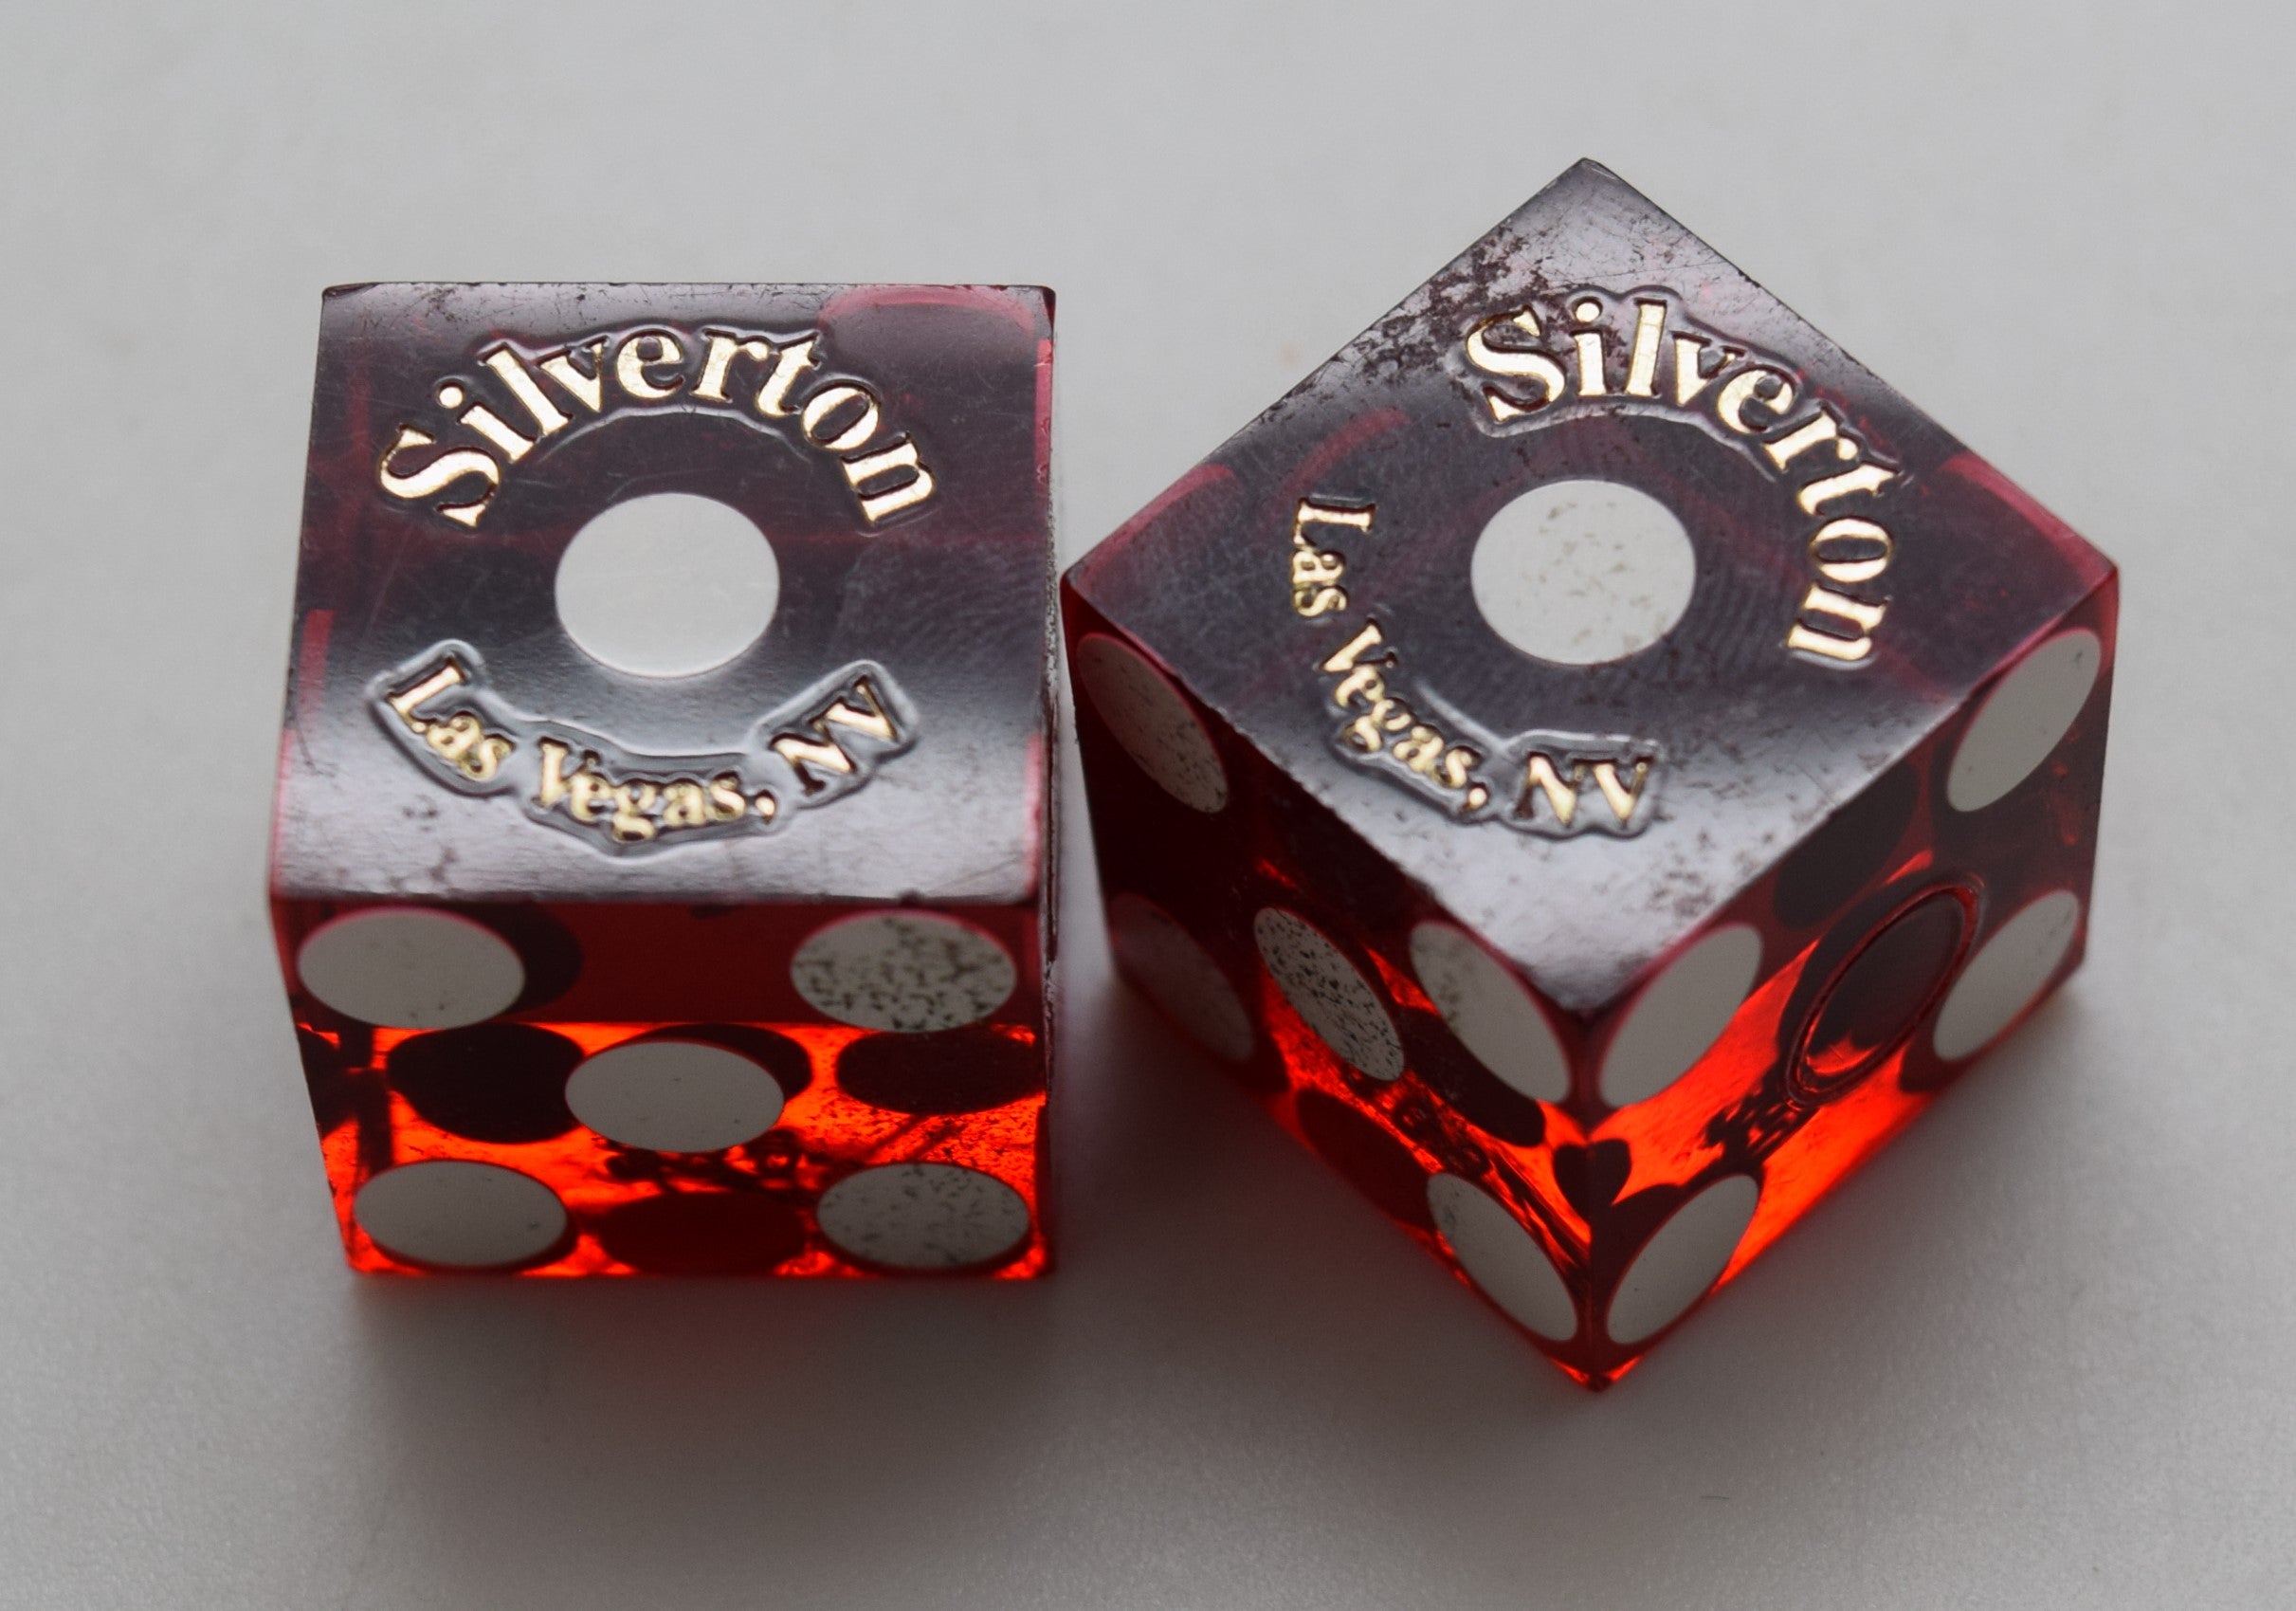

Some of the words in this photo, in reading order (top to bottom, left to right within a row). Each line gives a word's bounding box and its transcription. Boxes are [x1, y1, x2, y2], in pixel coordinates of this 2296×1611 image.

[380, 328, 936, 527] Silverton
[1466, 298, 1899, 661] Silverton
[1292, 496, 1376, 617] Las
[387, 660, 517, 781] Las
[533, 737, 777, 842] Vegas,
[769, 675, 899, 795] NV
[1321, 619, 1488, 813] Vegas,
[1518, 753, 1649, 825] NV
